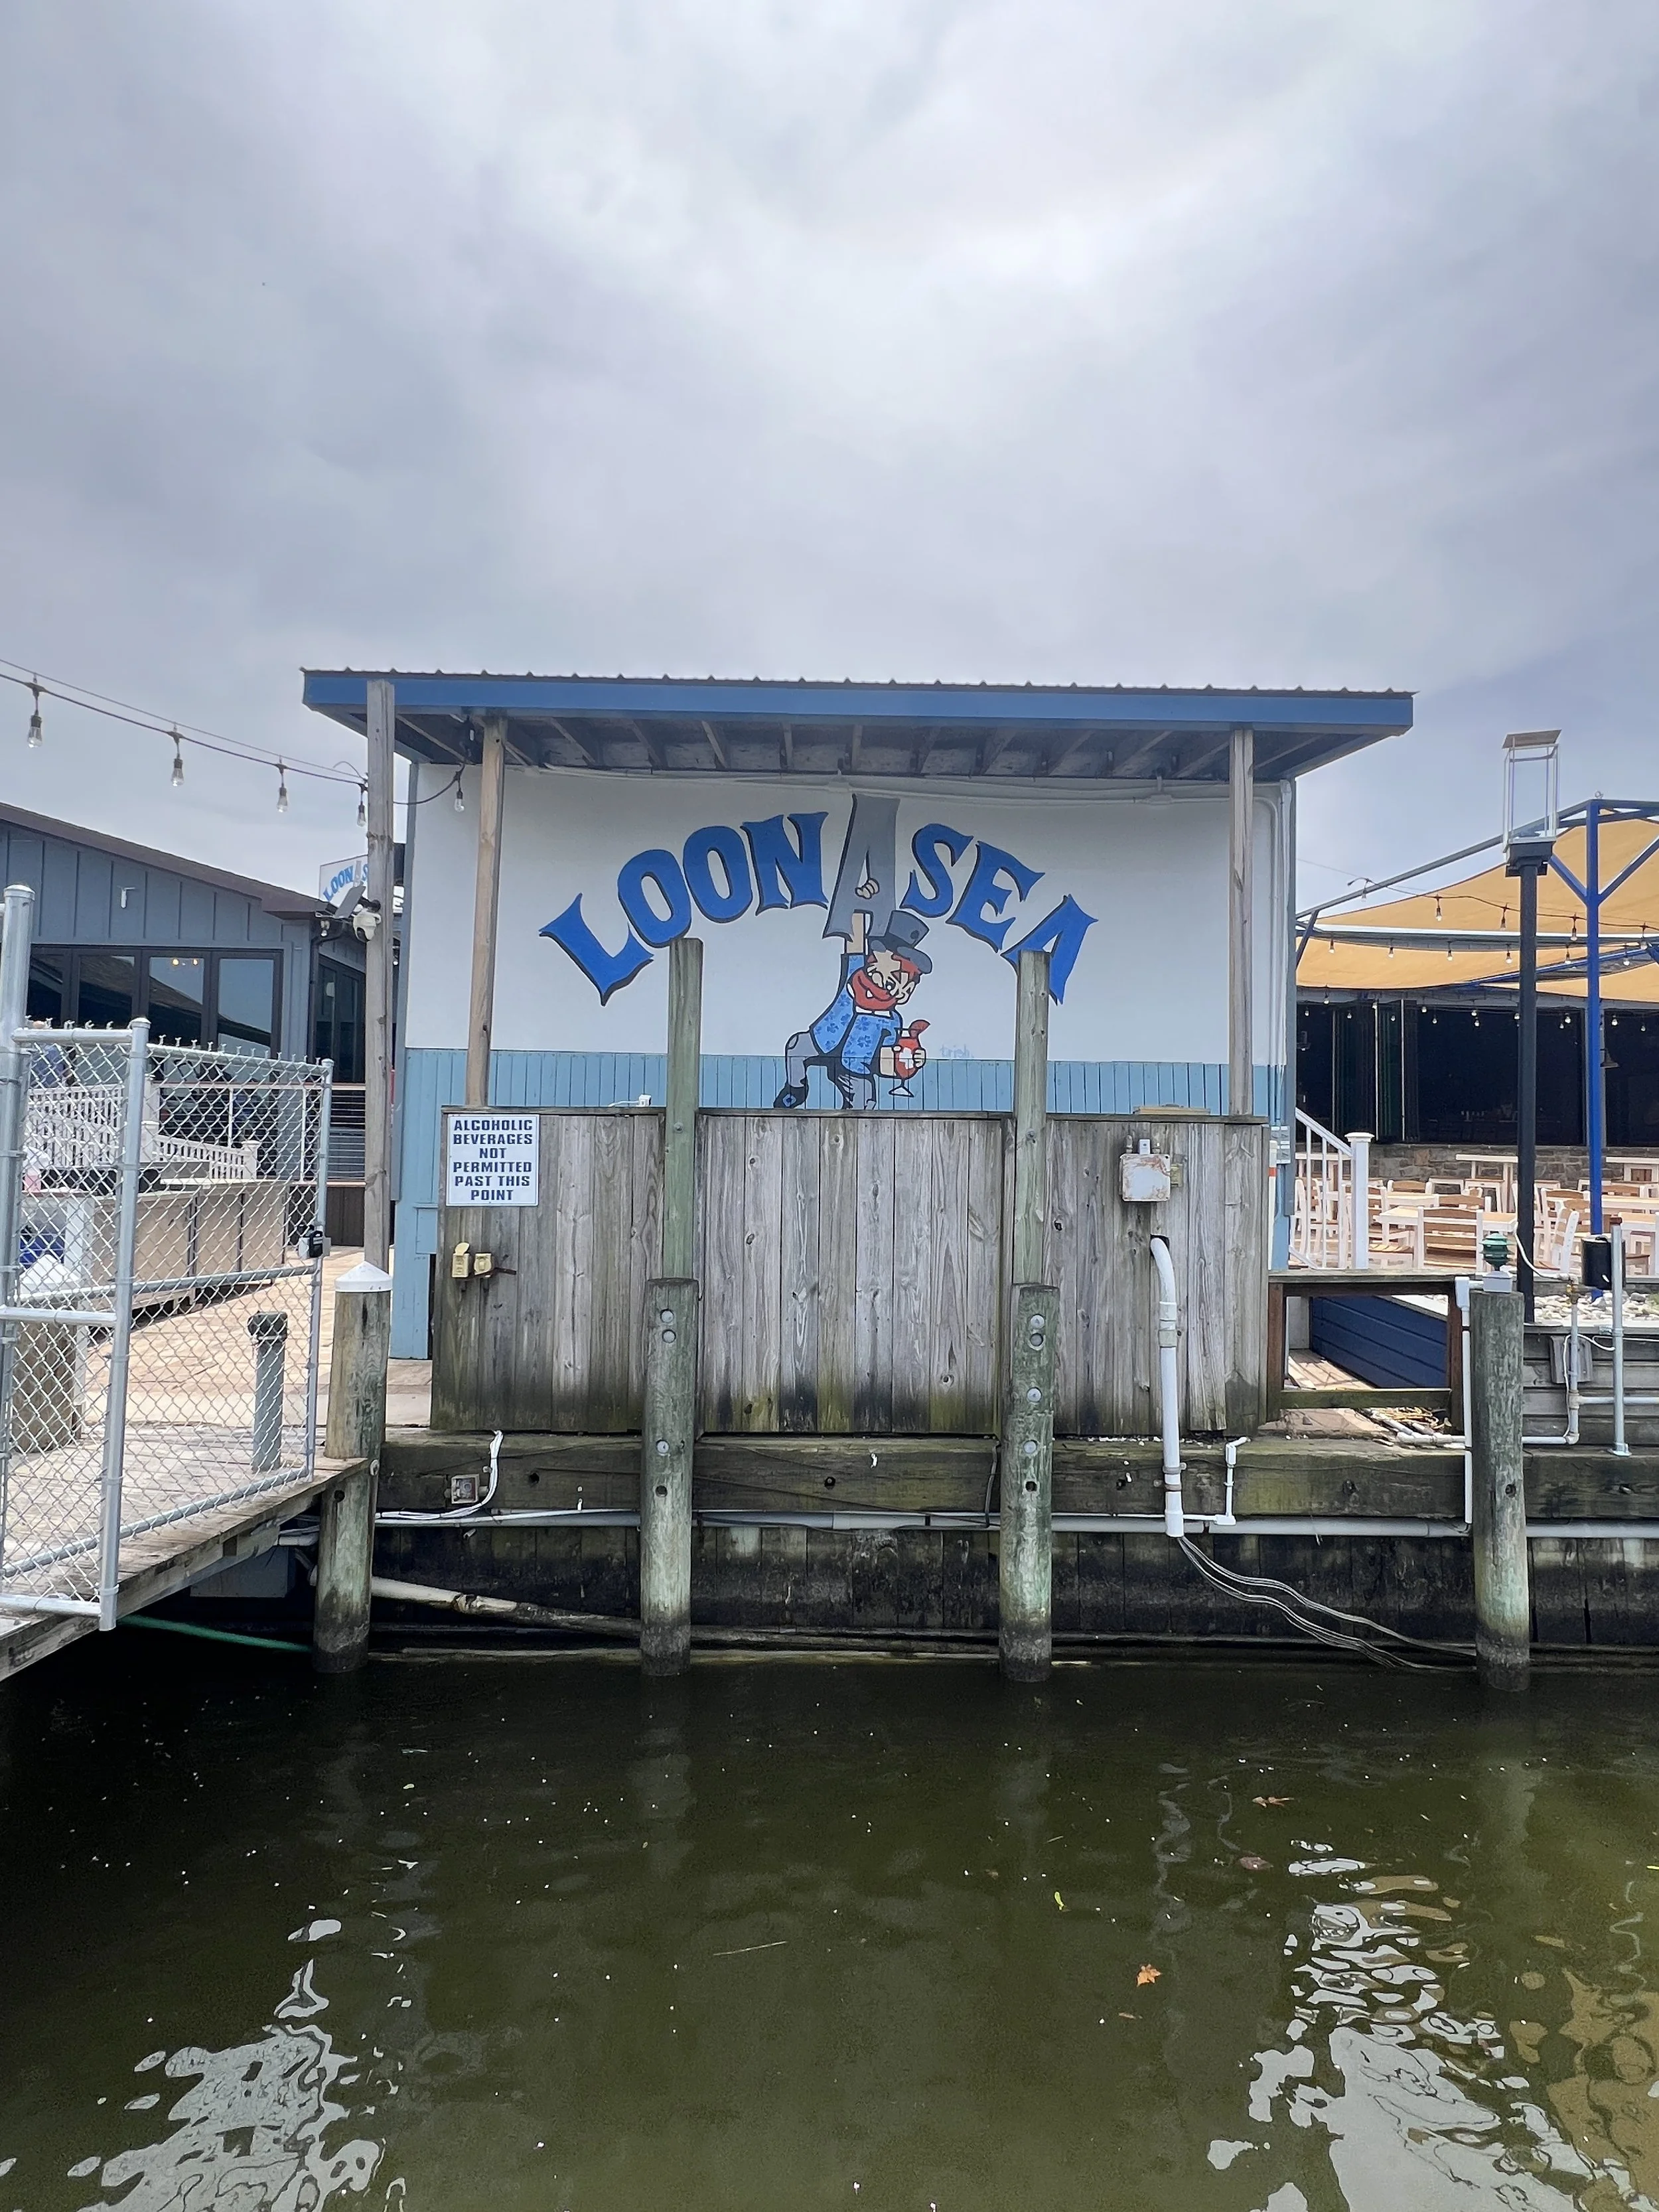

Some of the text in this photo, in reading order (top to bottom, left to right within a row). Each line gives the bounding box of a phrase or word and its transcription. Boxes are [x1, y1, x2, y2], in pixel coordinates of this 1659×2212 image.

[323, 865, 354, 901] LOON
[454, 1120, 532, 1131] ALCOHOLIC
[453, 1134, 532, 1145] BEVERAGES
[479, 1147, 506, 1159] NOT
[453, 1161, 532, 1173] PERMITTED
[455, 1175, 530, 1187] PAST THIS
[471, 1189, 514, 1201] POINT
